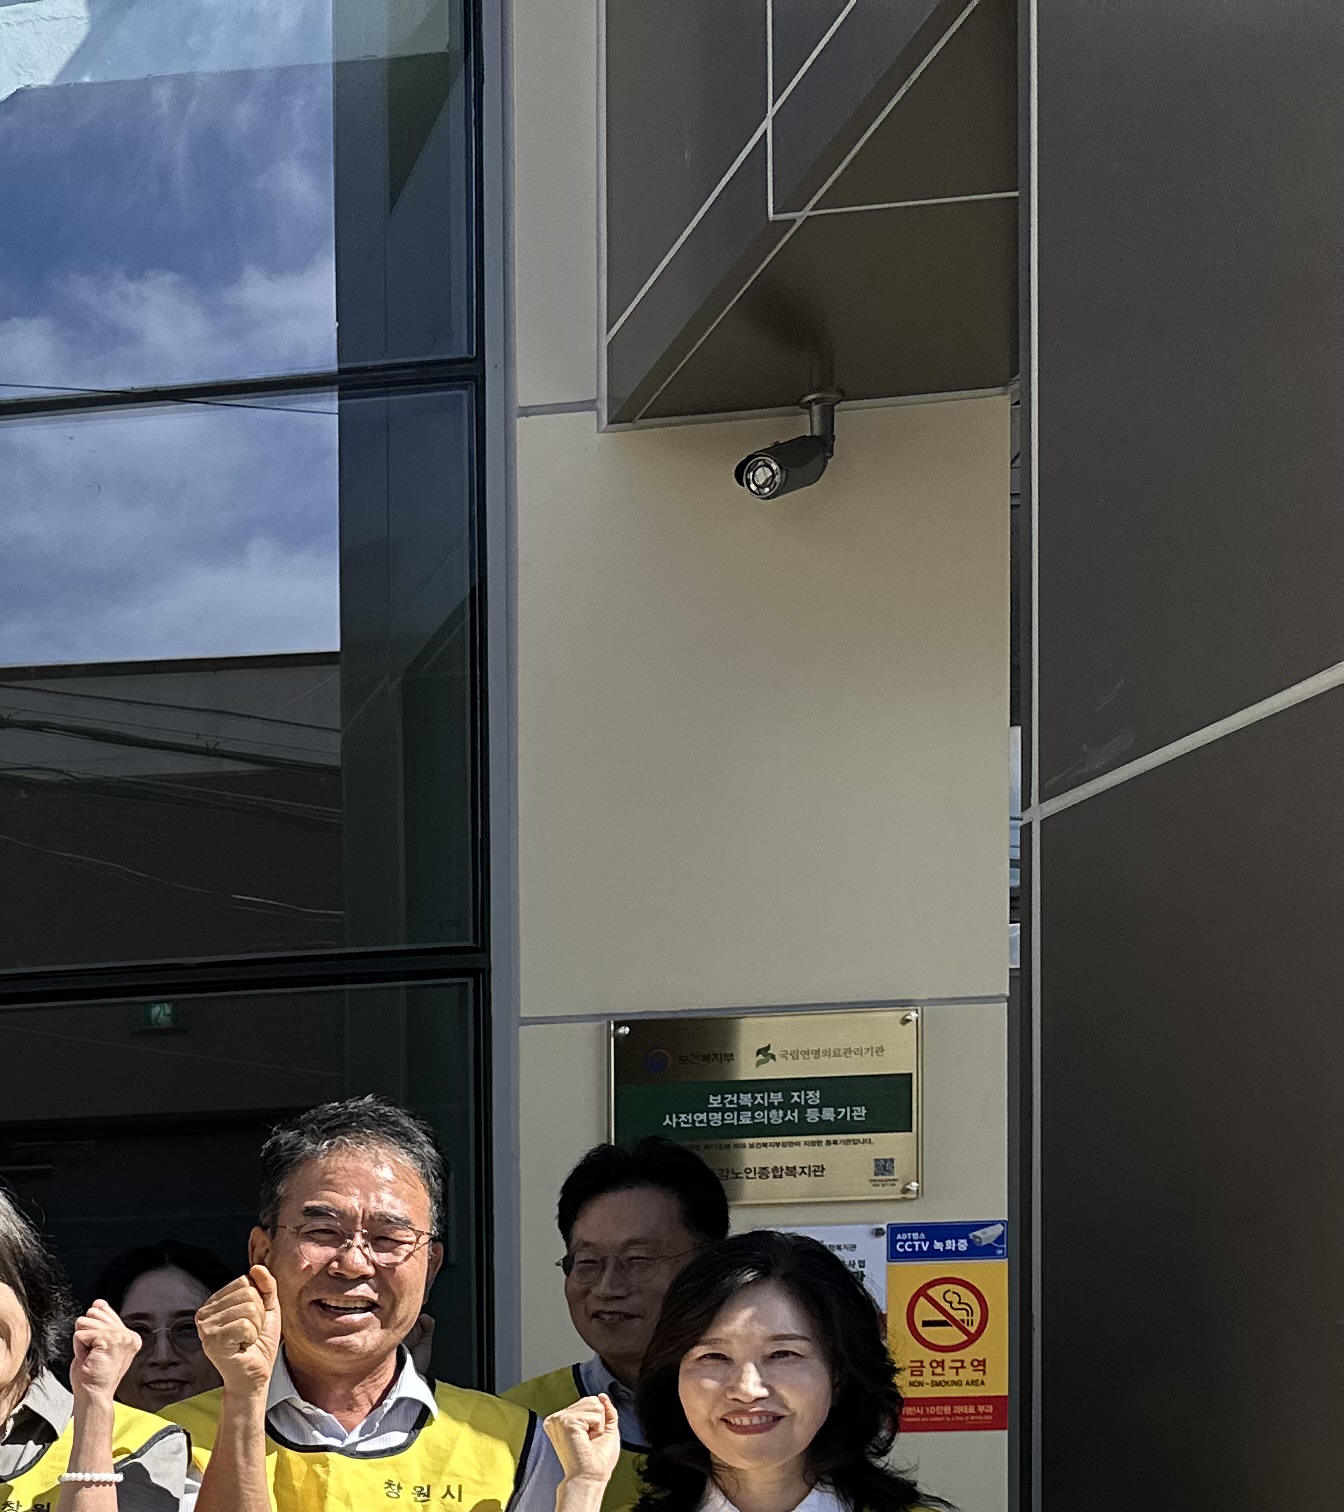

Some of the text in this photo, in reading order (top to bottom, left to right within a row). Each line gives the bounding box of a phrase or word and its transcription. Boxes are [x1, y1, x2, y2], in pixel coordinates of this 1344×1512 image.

[707, 1089, 821, 1109] 보건복지부 지정
[662, 1105, 867, 1128] 사전연명의료의향서 등록기관
[711, 1163, 826, 1182] 강노인종합복지관
[895, 1239, 969, 1253] CCTV 녹화중
[907, 1358, 987, 1378] 금연구역
[965, 1378, 986, 1387] AREA
[382, 1478, 464, 1505] 창원시
